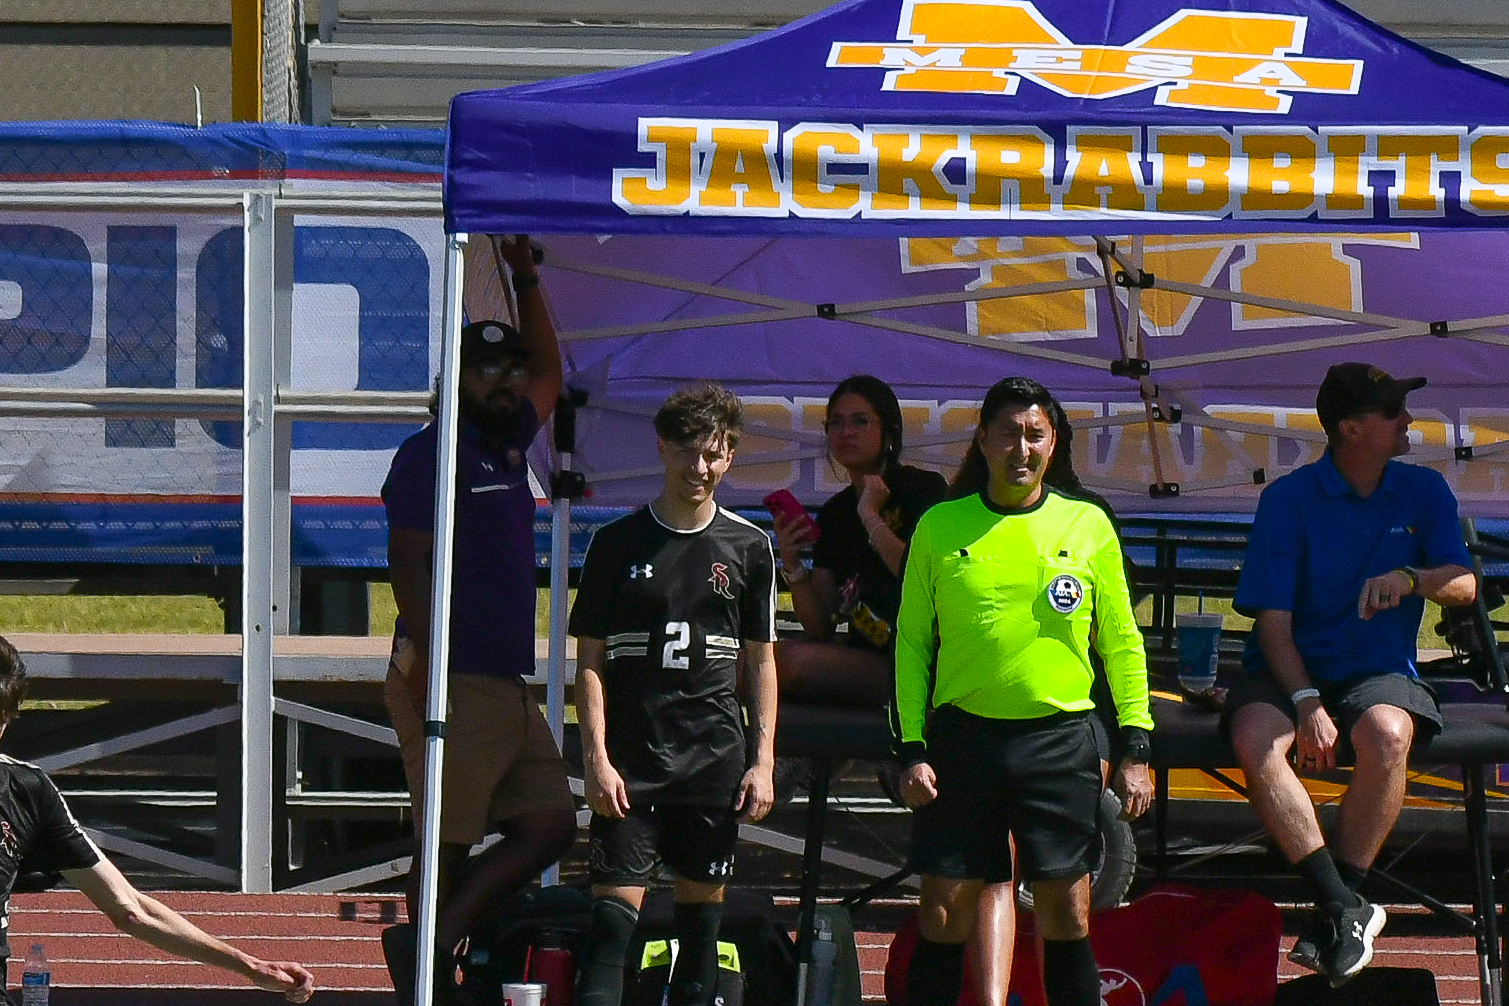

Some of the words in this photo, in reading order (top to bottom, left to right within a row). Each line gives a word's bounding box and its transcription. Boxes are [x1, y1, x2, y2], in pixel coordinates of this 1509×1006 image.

[879, 47, 1308, 87] MESA
[612, 118, 1509, 221] JACKRABBITS
[662, 621, 691, 670] 2
